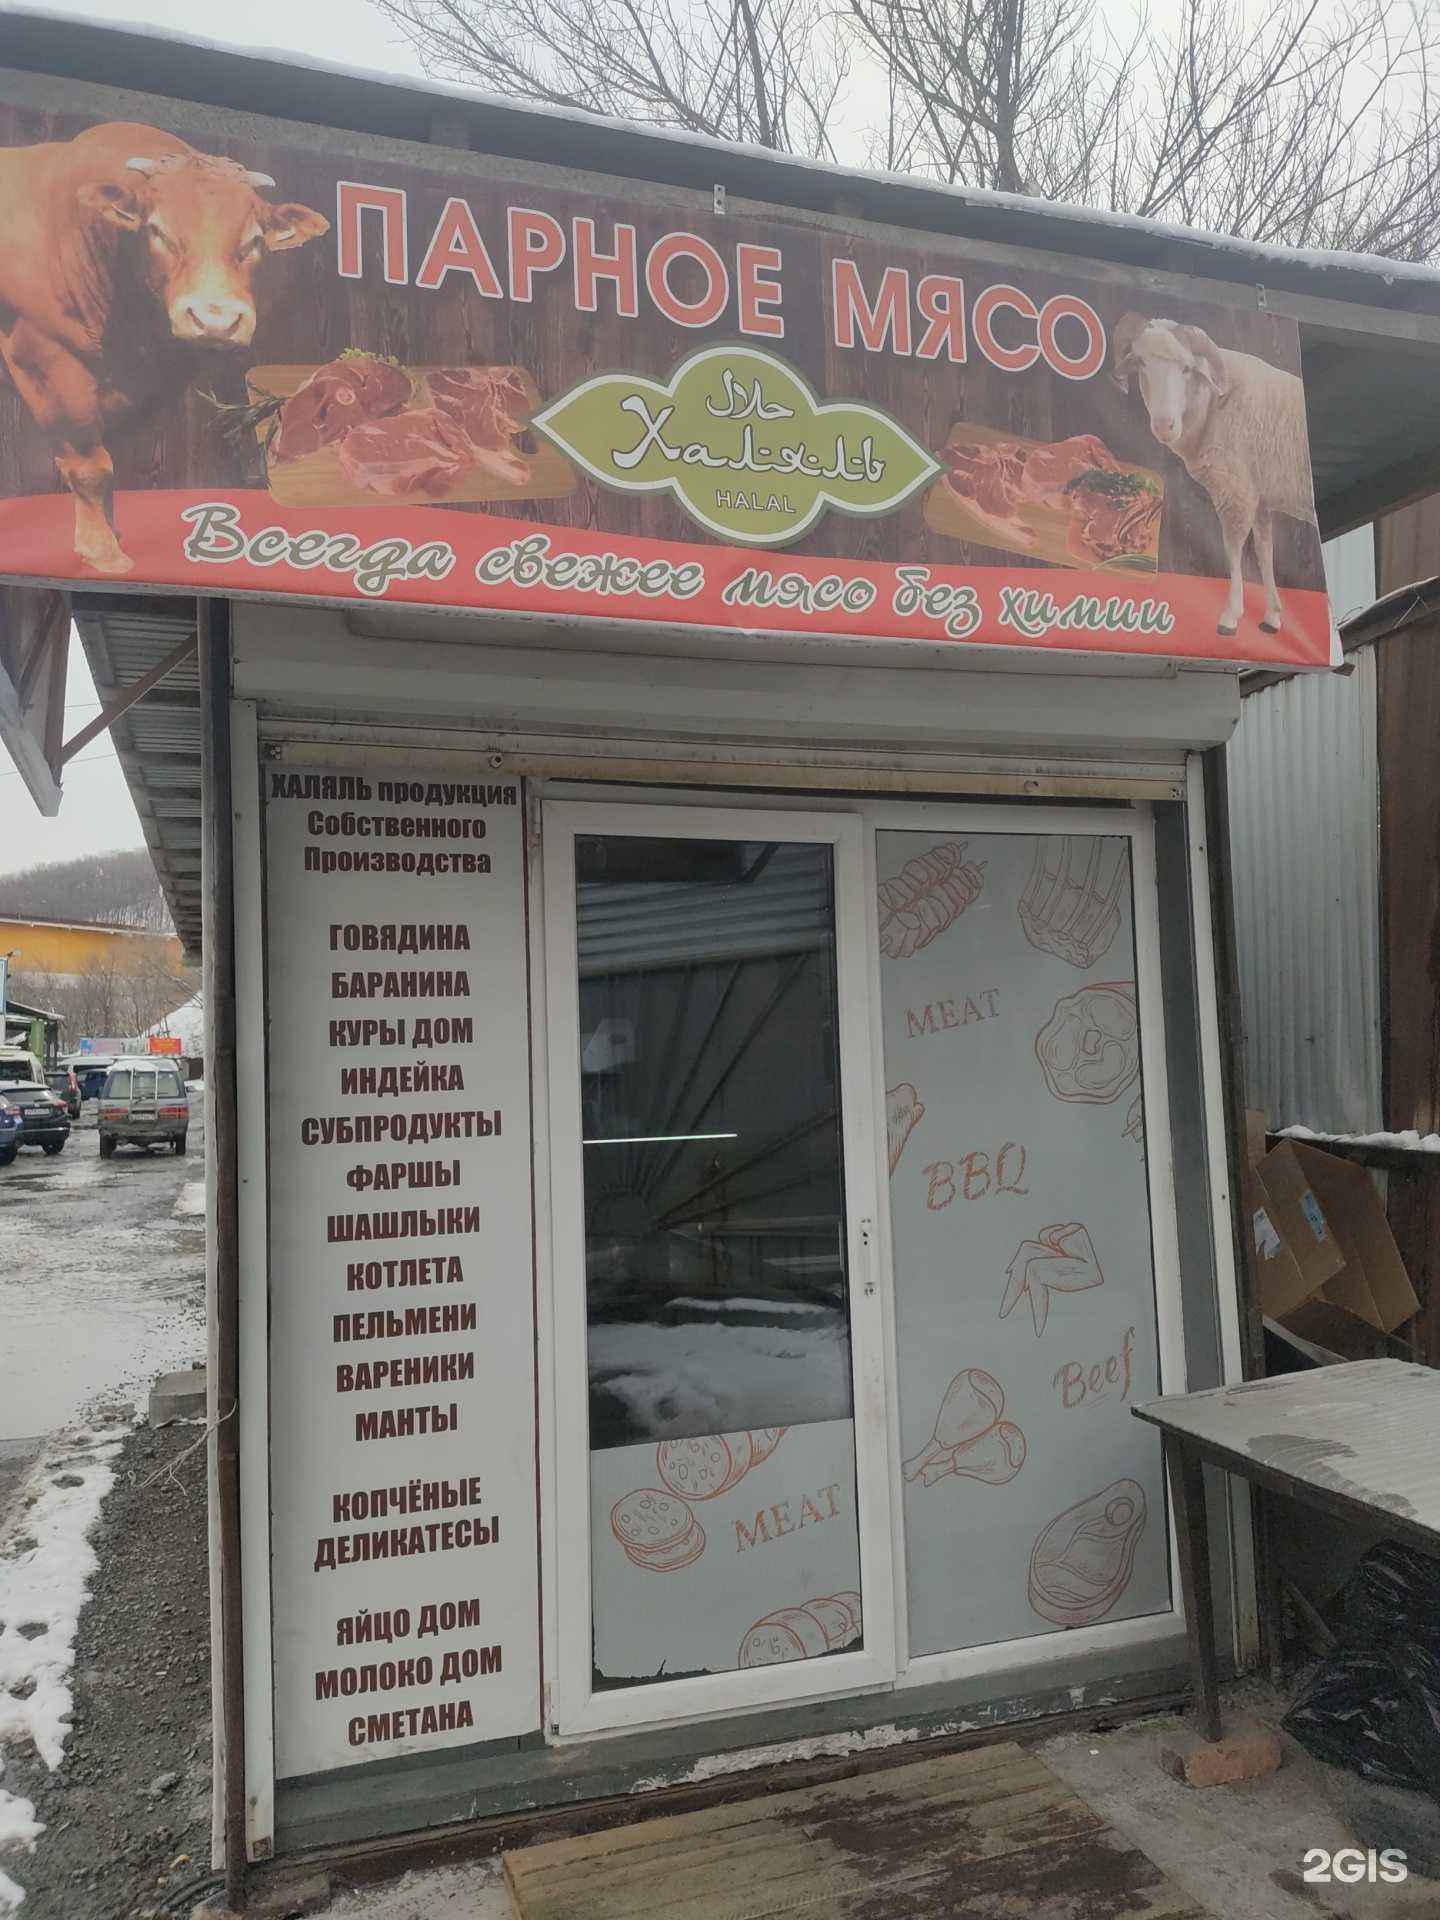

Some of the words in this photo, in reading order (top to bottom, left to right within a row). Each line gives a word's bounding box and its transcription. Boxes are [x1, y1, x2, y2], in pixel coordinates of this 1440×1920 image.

[336, 181, 786, 341] ПАРНОЕ
[832, 258, 1108, 382] МЯСО
[706, 368, 794, 420] حلال
[715, 489, 797, 513] HALAL
[181, 503, 456, 596] Всегда
[475, 534, 705, 598] свежее
[722, 567, 876, 613] мясо
[893, 566, 982, 638] без
[999, 585, 1175, 637] химии
[271, 773, 372, 801] ХАЛЯЛЬ
[378, 780, 517, 807] продукция
[307, 810, 487, 839] Собственного
[304, 847, 491, 876] Производства
[329, 924, 470, 954] ГОВЯДИНА
[331, 971, 470, 998] БАРАНИНА
[329, 1019, 405, 1047] КУРЫ
[412, 1017, 473, 1048] ДОМ
[905, 988, 1001, 1039] MEAT
[341, 1061, 464, 1097] ИНДЕЙКА
[301, 1110, 502, 1145] СУБПРОДУКТЫ
[922, 1142, 1029, 1211] BBQ
[327, 1206, 480, 1243] ШАШЛЫКИ
[347, 1256, 464, 1291] КОТЛЕТА
[333, 1303, 477, 1342] ПЕЛЬМЕНИ
[336, 1352, 474, 1392] ВАРЕНИКИ
[1053, 1326, 1136, 1408] Beef
[355, 1404, 458, 1441] МАНТЫ
[333, 1477, 482, 1523] КОПЧЁНЫЕ
[732, 1483, 842, 1553] MEAT
[314, 1516, 499, 1572] ДЕЛИКАТЕСЫ
[337, 1608, 410, 1645] ЯЙЦО
[418, 1599, 480, 1638] ДОМ
[315, 1656, 432, 1700] МОЛОКО
[440, 1646, 502, 1684] ДОМ
[348, 1700, 474, 1746] СМЕТАНА
